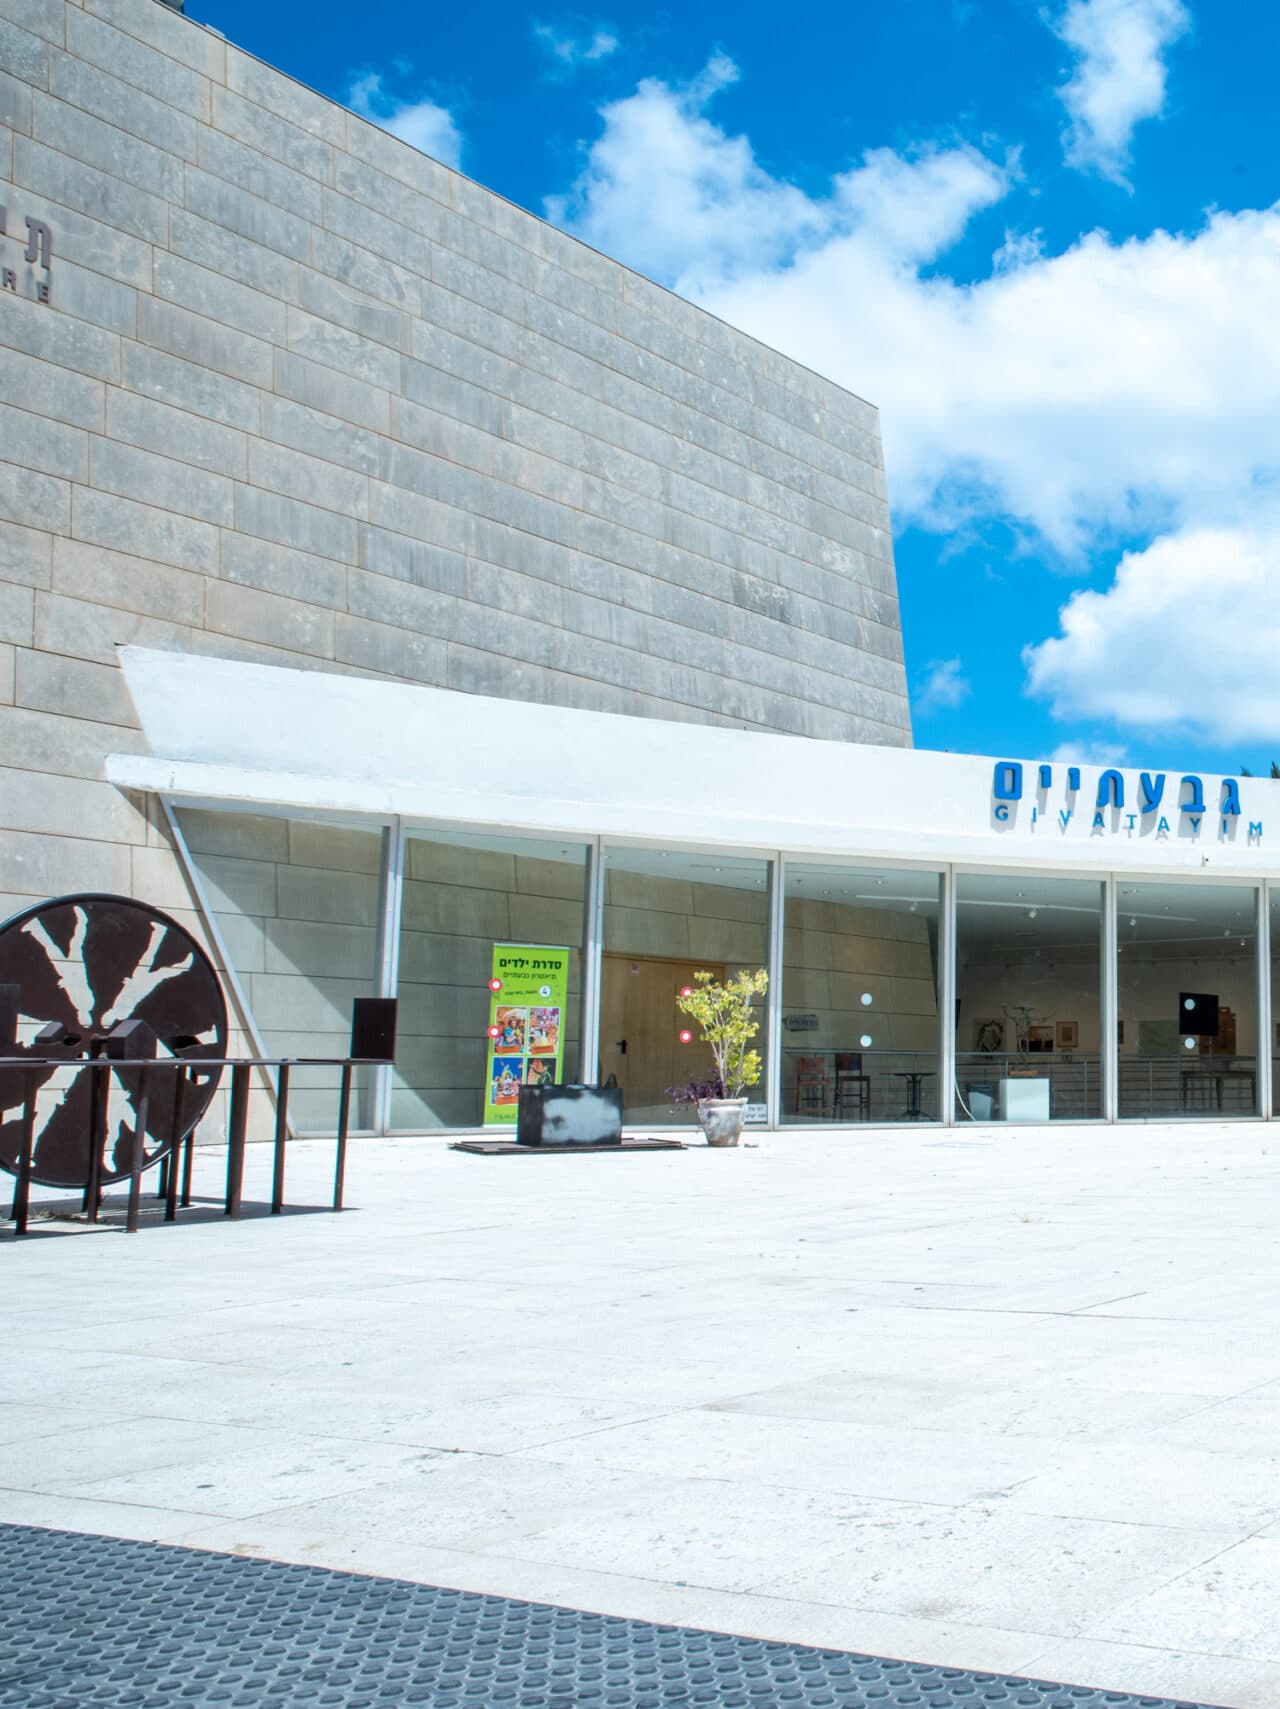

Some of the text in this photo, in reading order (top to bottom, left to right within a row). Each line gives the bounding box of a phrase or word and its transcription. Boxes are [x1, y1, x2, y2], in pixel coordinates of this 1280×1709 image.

[994, 762, 1242, 815] גבעתיים
[995, 805, 1263, 837] GIVATAYIM
[499, 957, 562, 970] סדרת ילדים
